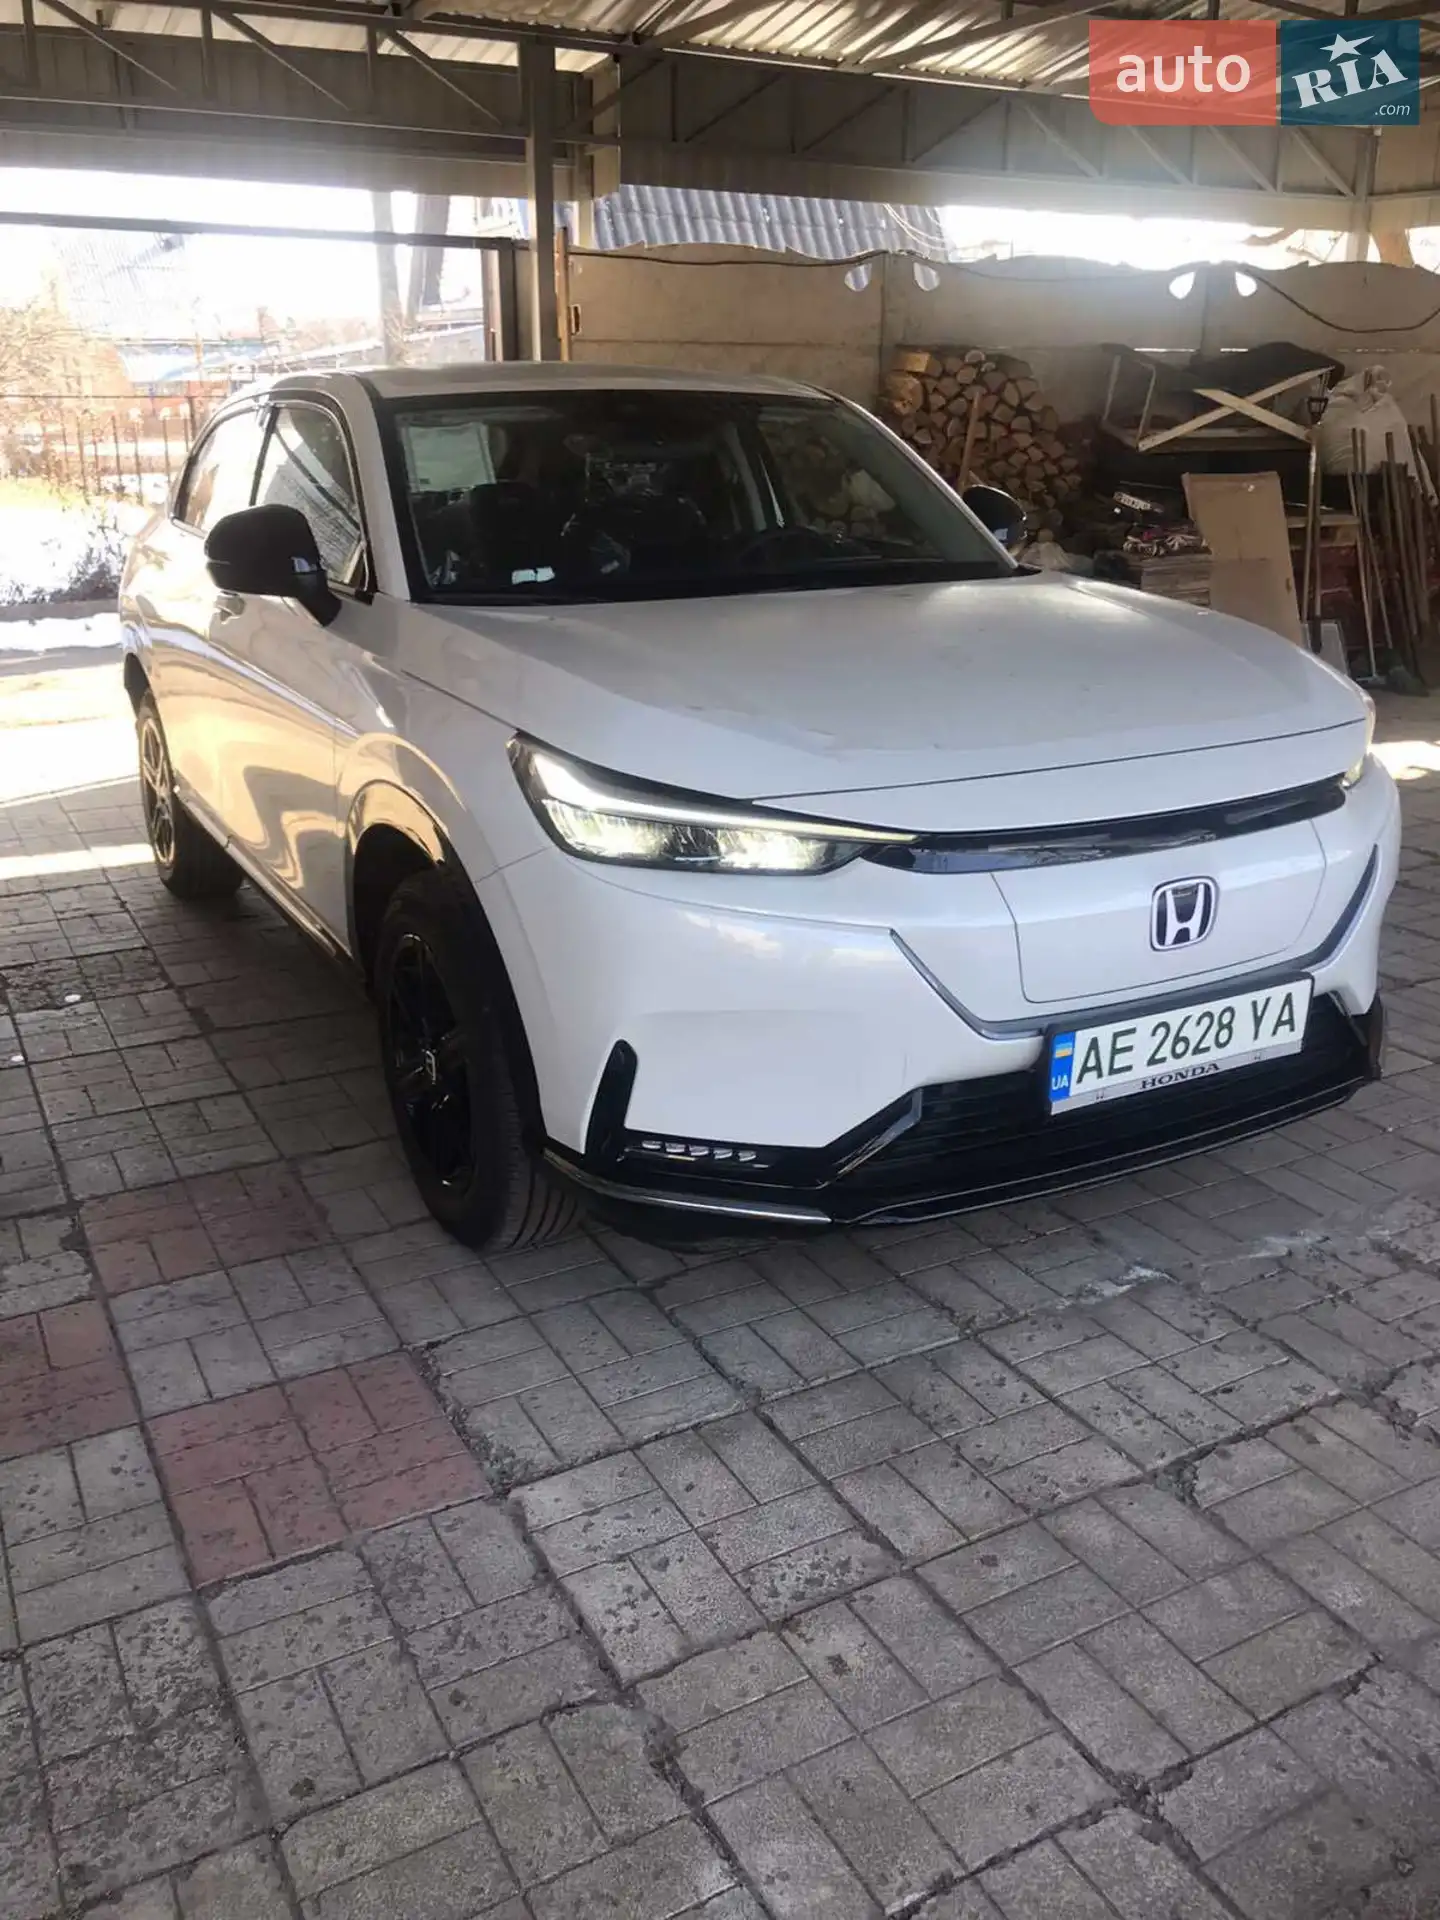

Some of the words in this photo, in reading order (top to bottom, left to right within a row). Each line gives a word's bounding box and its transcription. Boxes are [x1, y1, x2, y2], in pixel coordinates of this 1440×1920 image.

[1076, 1027, 1137, 1084] AE
[1146, 1006, 1236, 1067] 2628
[1251, 992, 1296, 1041] YA
[1052, 1072, 1069, 1091] UA
[1139, 1062, 1220, 1090] HONDA
